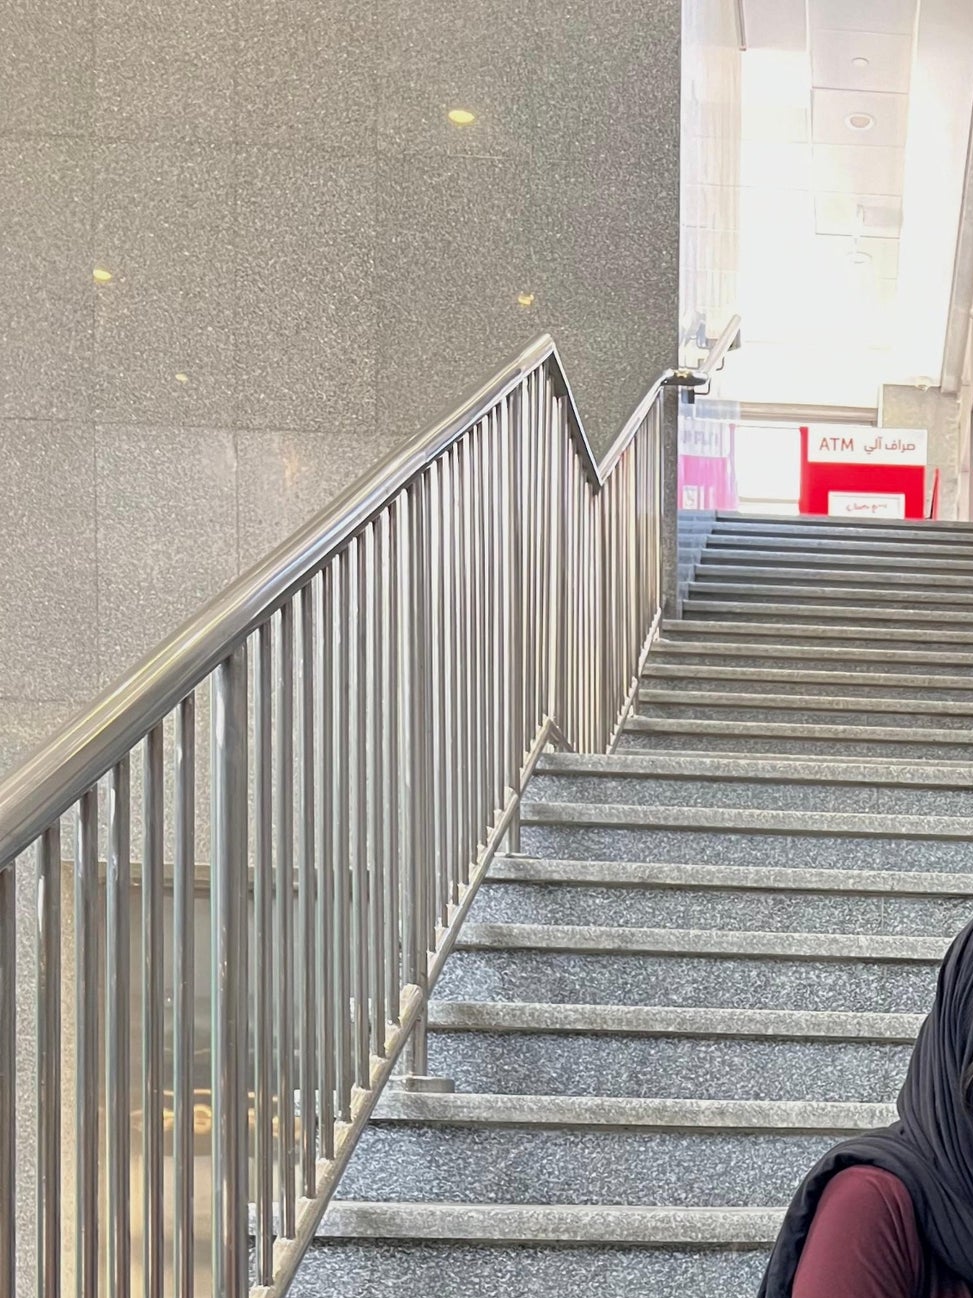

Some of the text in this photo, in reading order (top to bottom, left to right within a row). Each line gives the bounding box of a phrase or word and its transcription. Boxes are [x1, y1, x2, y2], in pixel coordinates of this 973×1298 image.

[819, 437, 854, 452] ATM
[864, 436, 916, 455] صراف آلي
